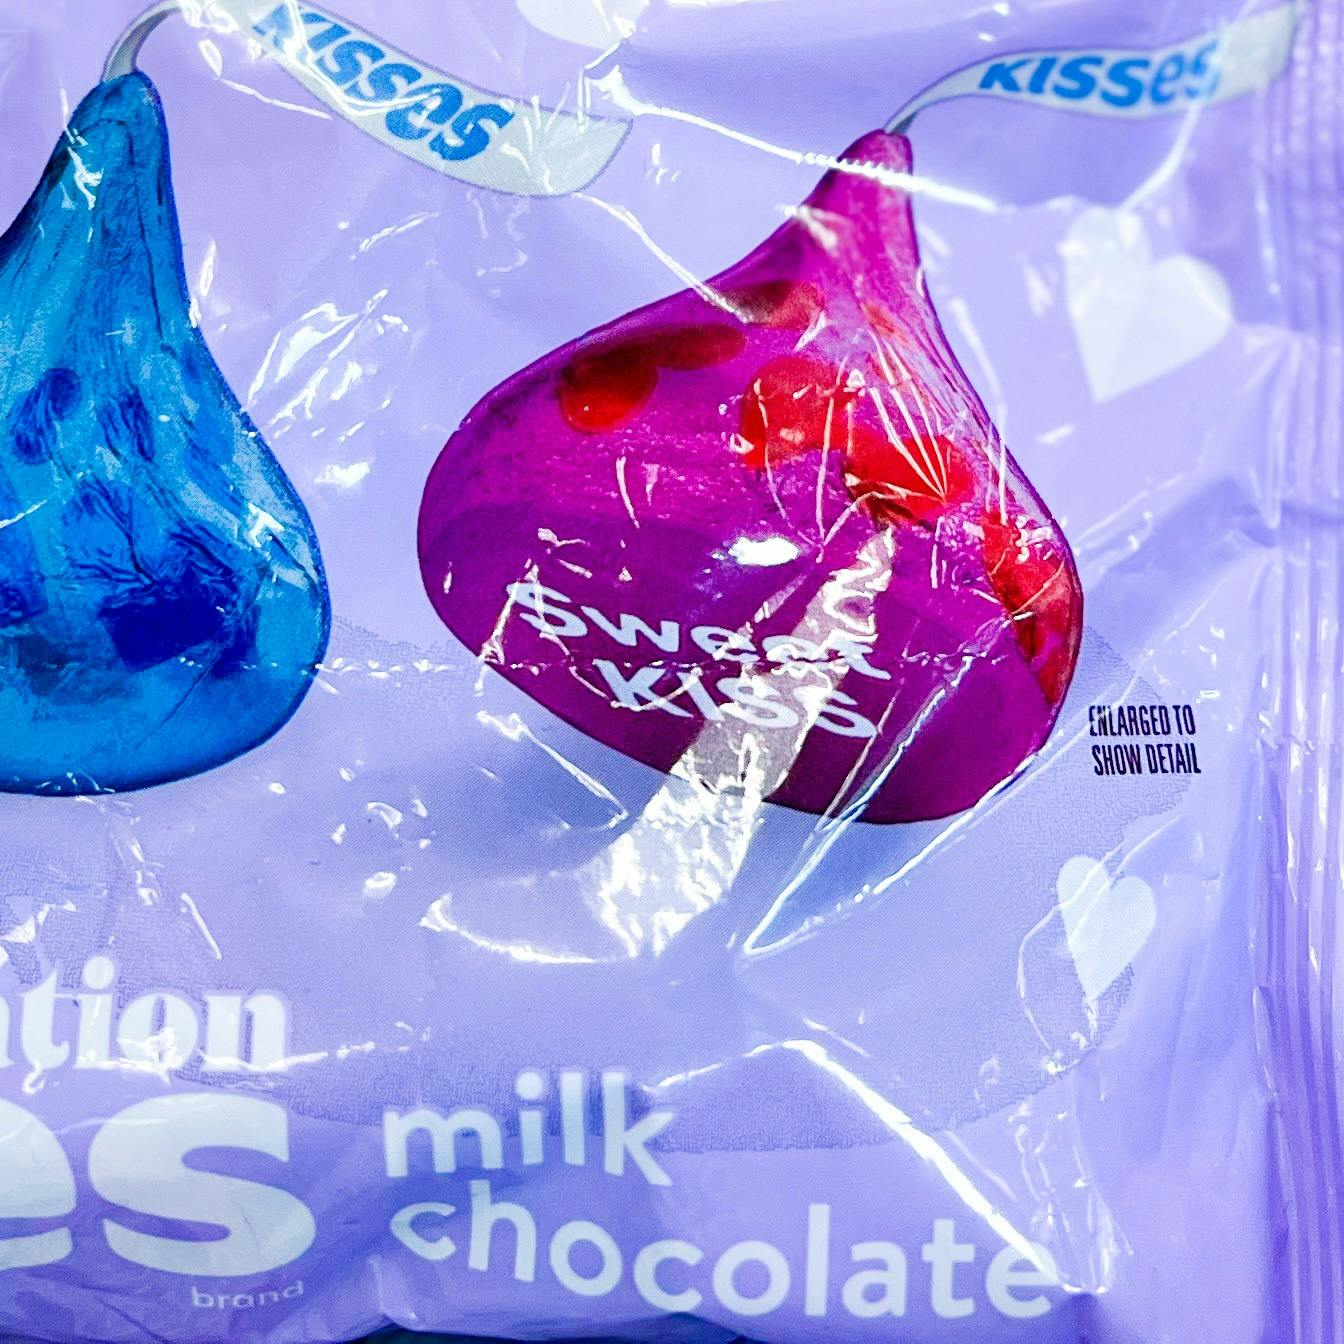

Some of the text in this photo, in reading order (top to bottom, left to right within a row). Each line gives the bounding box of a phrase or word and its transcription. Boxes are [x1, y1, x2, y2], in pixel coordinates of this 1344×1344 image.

[593, 658, 878, 739] KISS
[1088, 704, 1196, 737] ENLARGED TO
[1091, 742, 1202, 776] SHOW DETAIL
[383, 1068, 678, 1187] milk
[389, 1179, 1056, 1322] chocolate
[190, 1280, 304, 1309] brand
